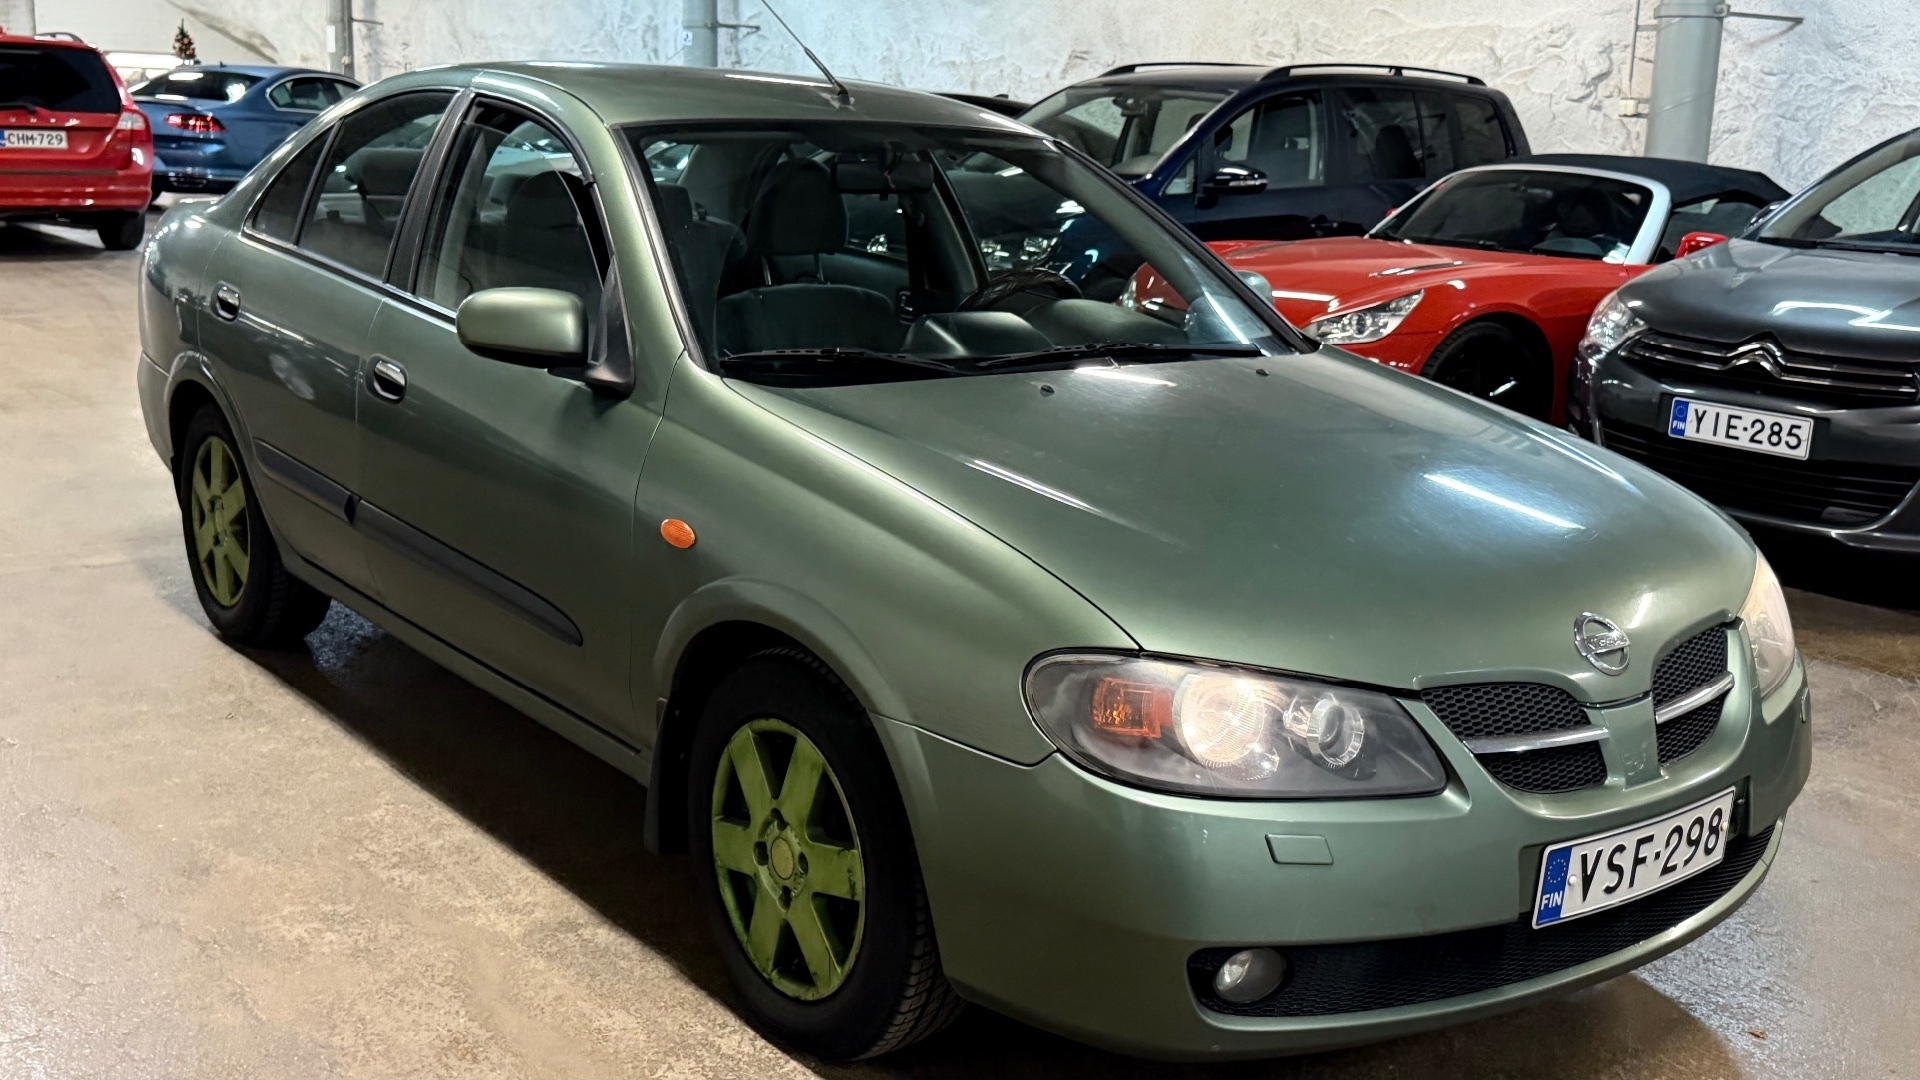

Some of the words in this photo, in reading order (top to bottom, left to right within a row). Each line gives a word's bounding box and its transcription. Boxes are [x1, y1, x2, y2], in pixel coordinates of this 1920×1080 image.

[7, 132, 63, 145] CHM-729
[1672, 420, 1685, 430] FIN
[1694, 408, 1802, 450] YIE-285
[1581, 807, 1723, 903] VSF-298
[1540, 890, 1563, 911] FIN
